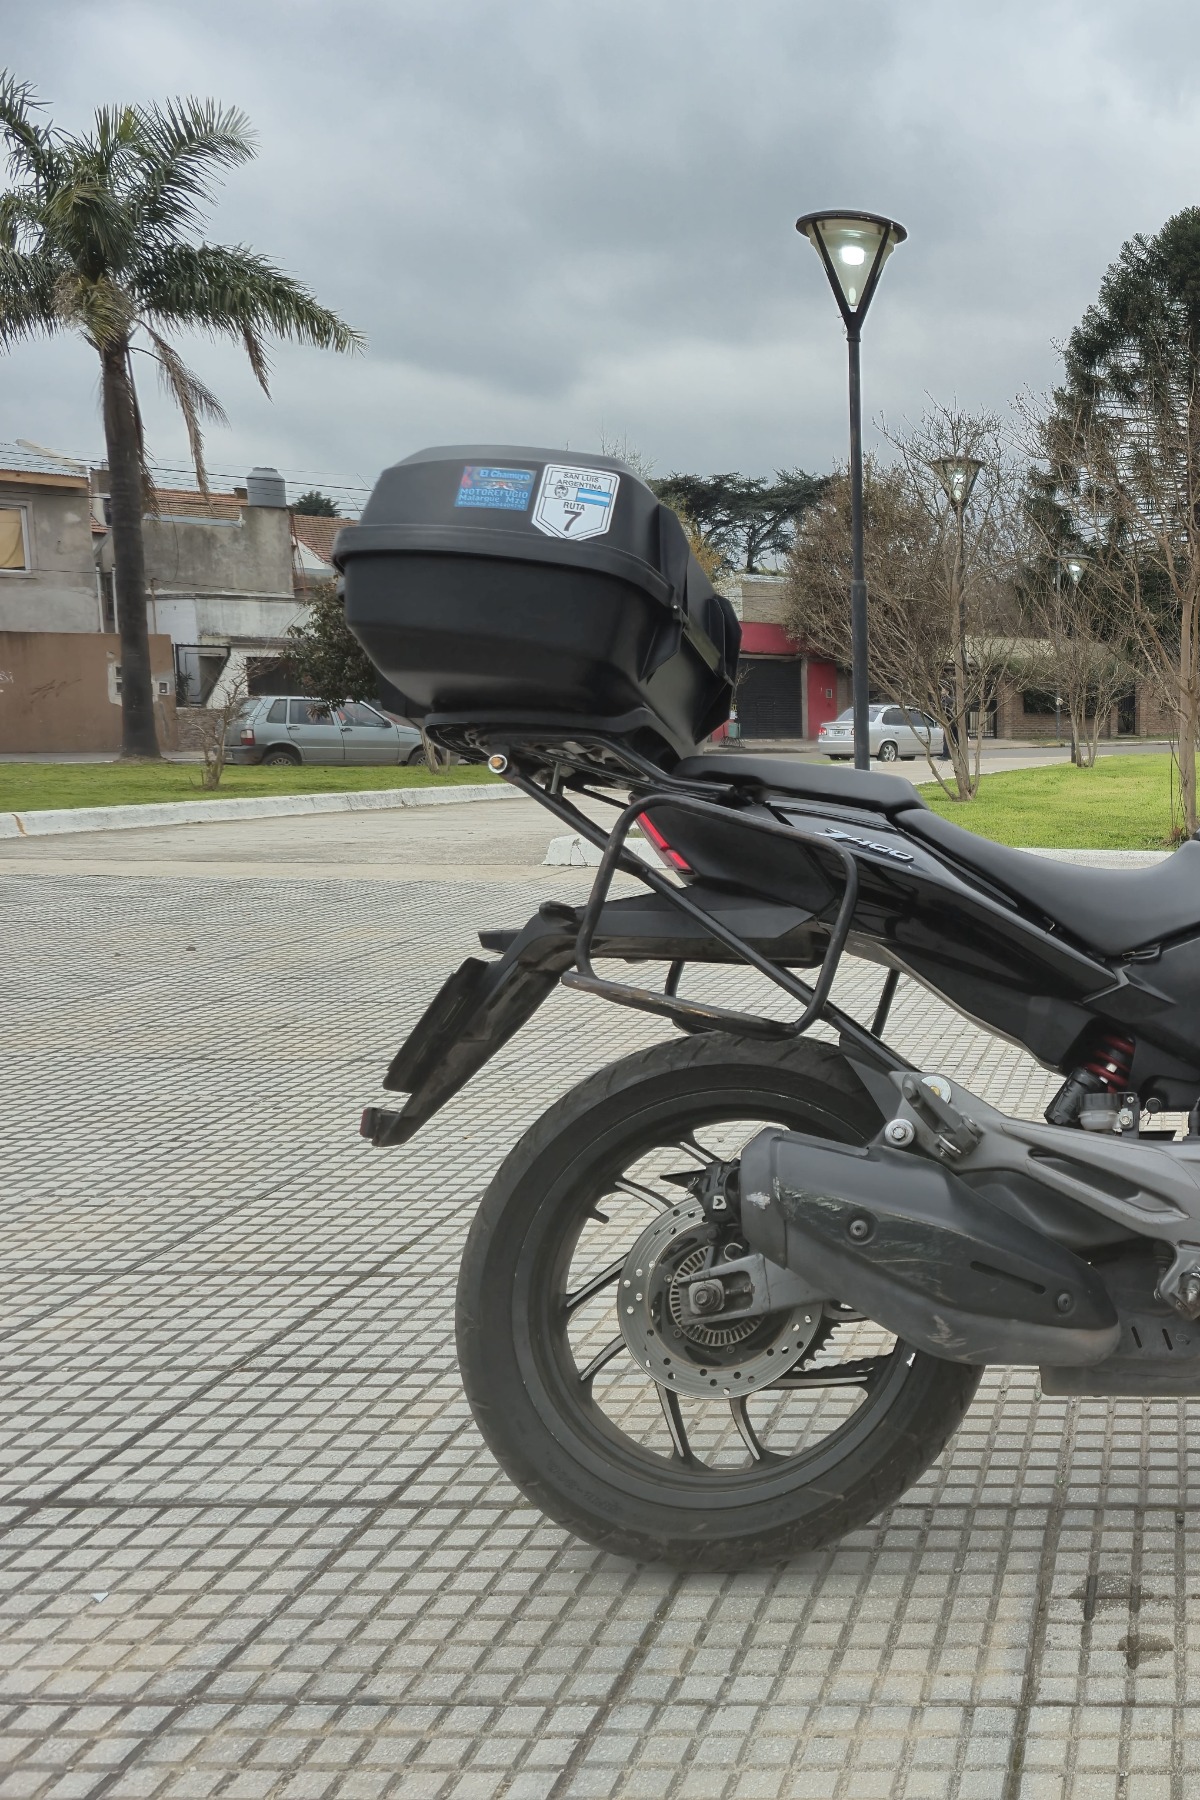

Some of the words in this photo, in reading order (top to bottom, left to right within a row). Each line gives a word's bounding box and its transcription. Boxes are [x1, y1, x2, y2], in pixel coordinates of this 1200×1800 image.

[480, 469, 490, 478] El
[563, 473, 580, 481] SAN
[581, 475, 600, 483] LUIS
[556, 479, 603, 491] ARGENTINA
[460, 488, 529, 499] MOTOREFUGIO
[563, 501, 586, 512] RUTA
[563, 509, 583, 532] 7
